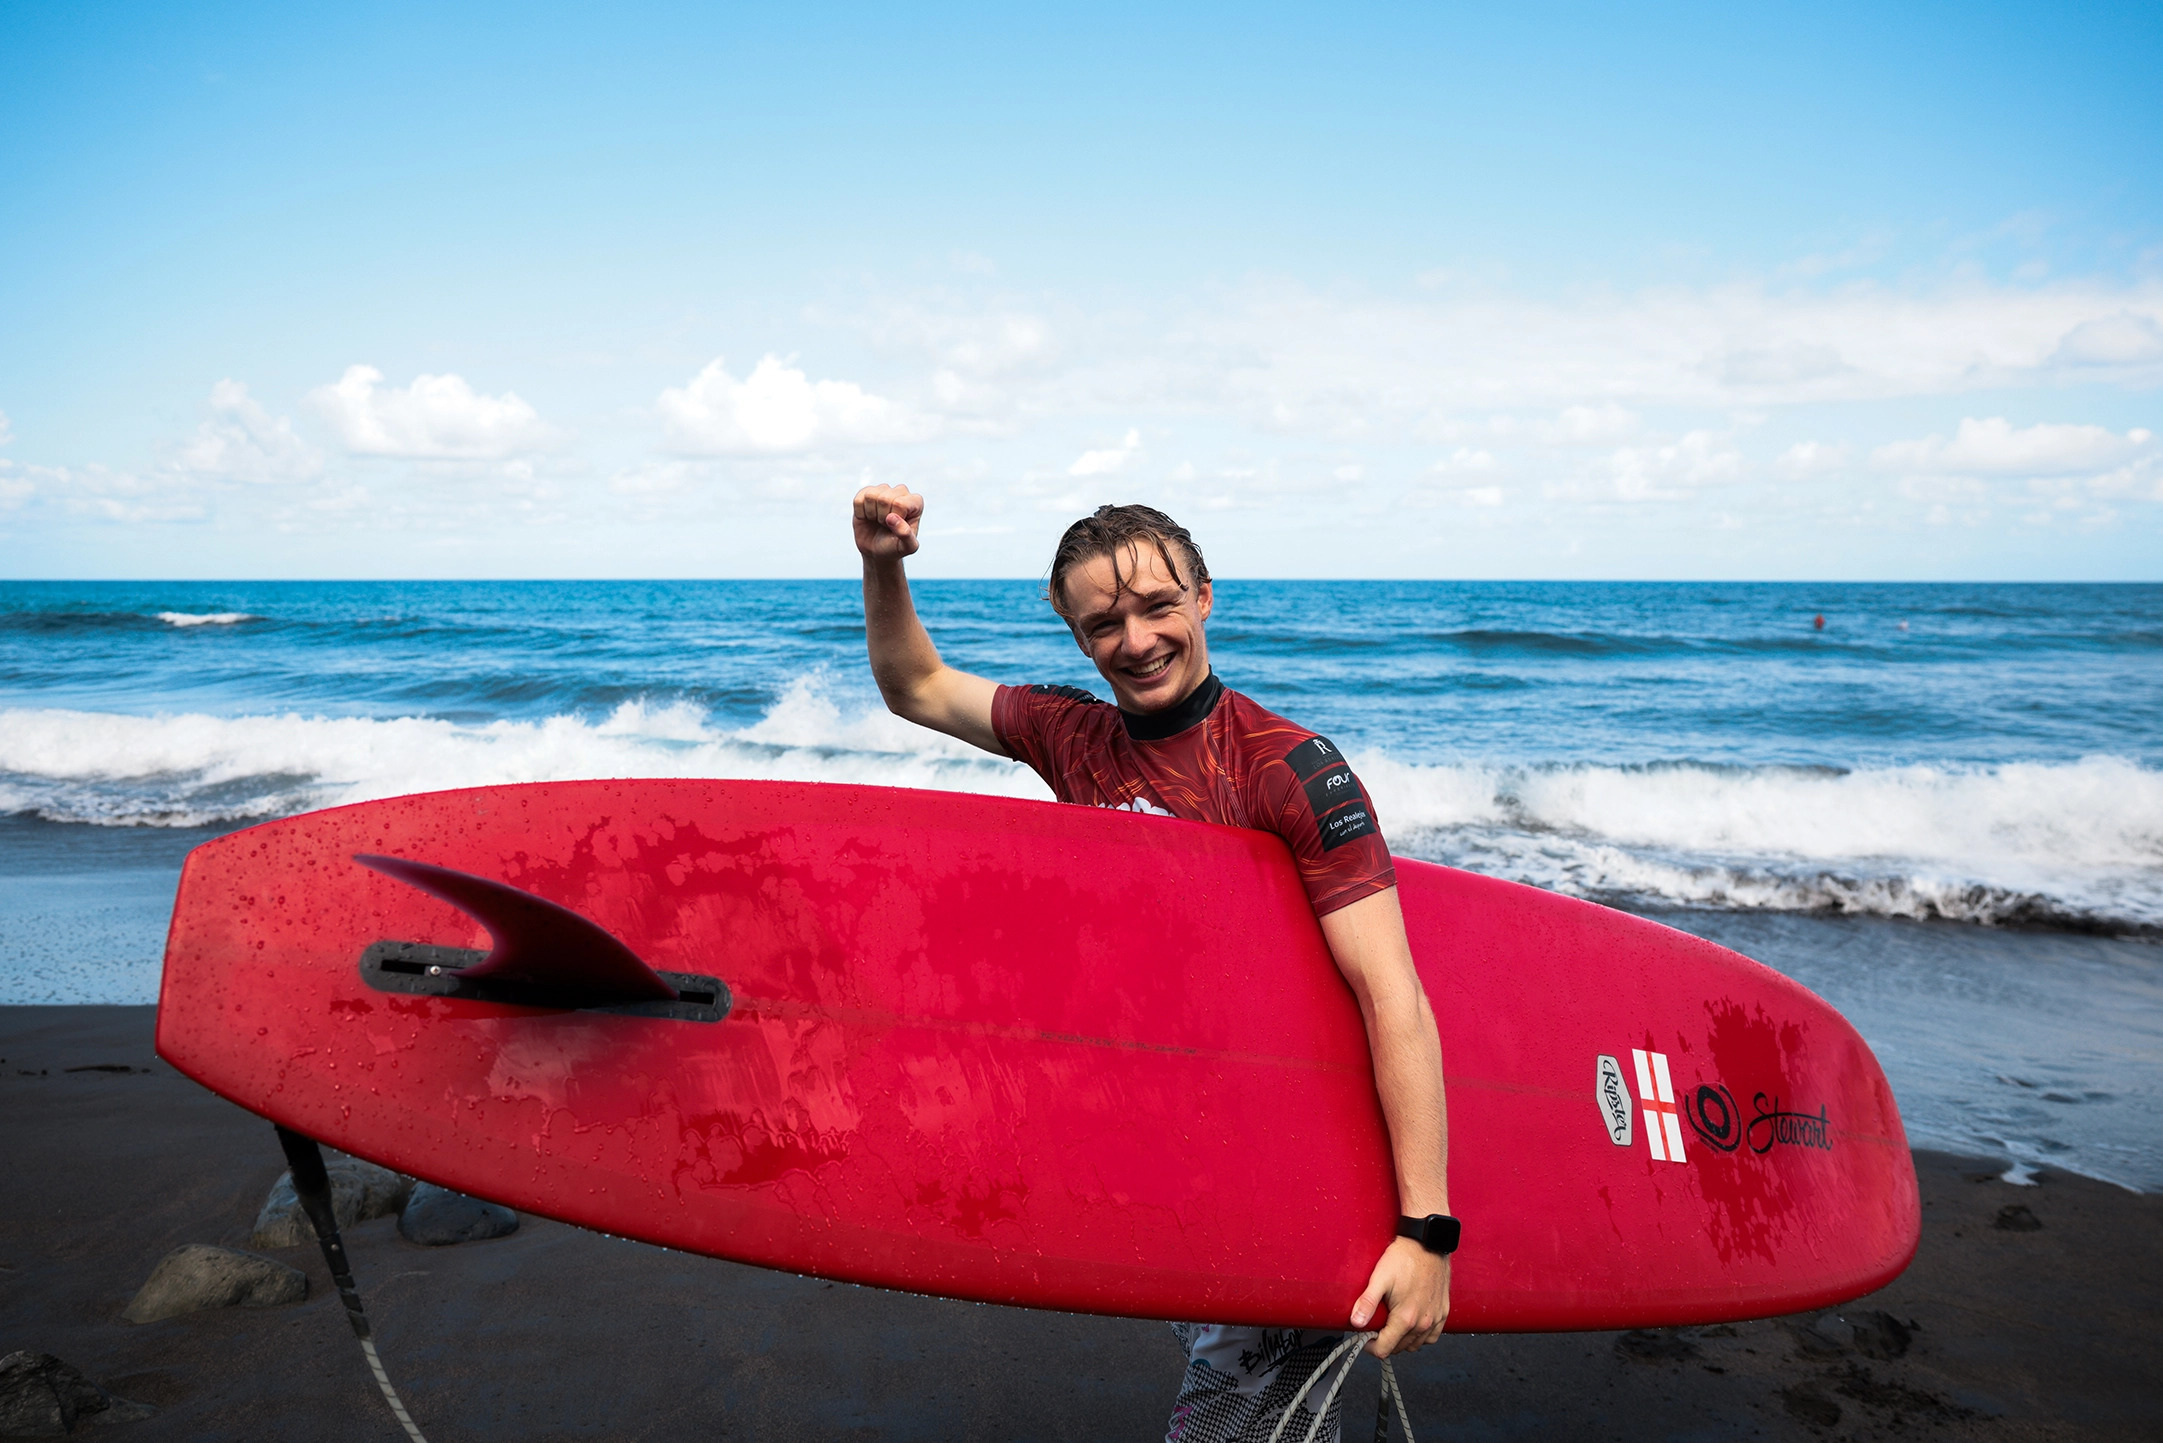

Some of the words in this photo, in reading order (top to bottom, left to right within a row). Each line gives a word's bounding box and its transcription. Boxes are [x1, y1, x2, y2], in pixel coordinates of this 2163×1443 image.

[1329, 820, 1343, 830] Los
[1603, 1059, 1627, 1141] Ripster
[1747, 1092, 1833, 1154] Stewart
